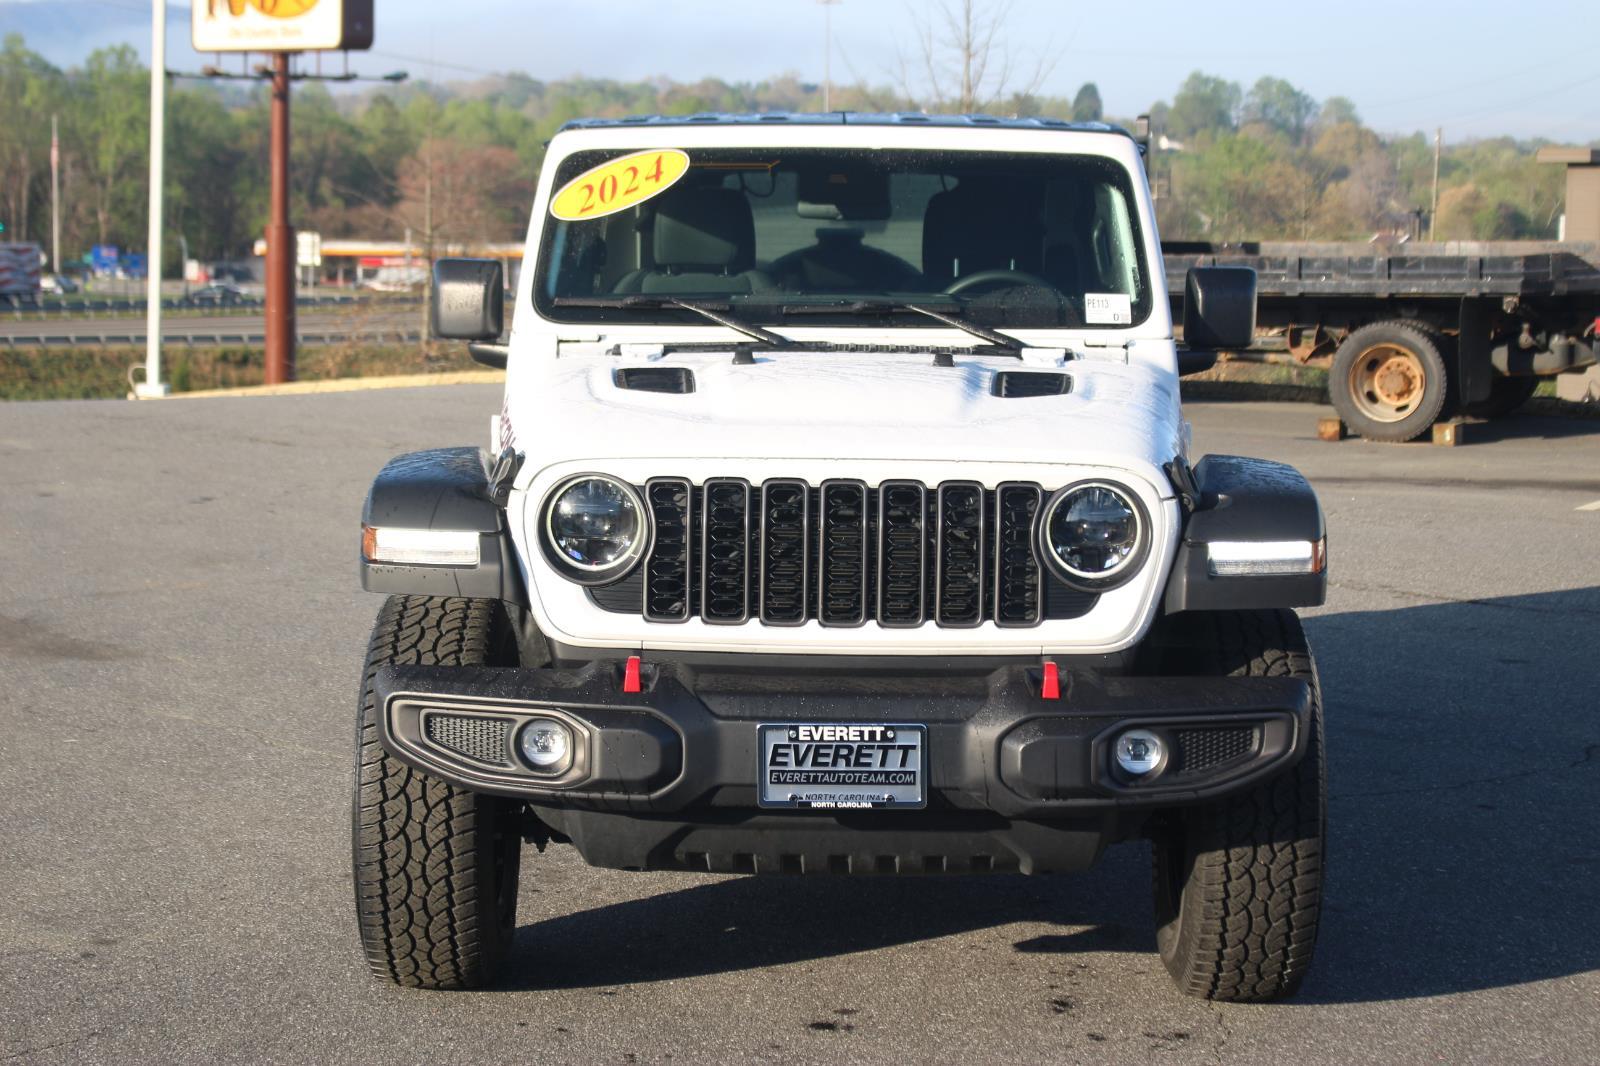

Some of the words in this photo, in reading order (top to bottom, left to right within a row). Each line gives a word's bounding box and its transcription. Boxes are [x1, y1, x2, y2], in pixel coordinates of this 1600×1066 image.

[578, 154, 664, 215] 2024
[798, 726, 885, 741] EVERETT
[769, 743, 917, 768] EVERETT
[771, 772, 915, 784] EVERETTAUTOTEAM.COM
[805, 793, 836, 801] NORTH
[838, 793, 881, 801] CAROLINA
[811, 801, 836, 809] NORTH
[837, 801, 873, 809] CAROLINA
